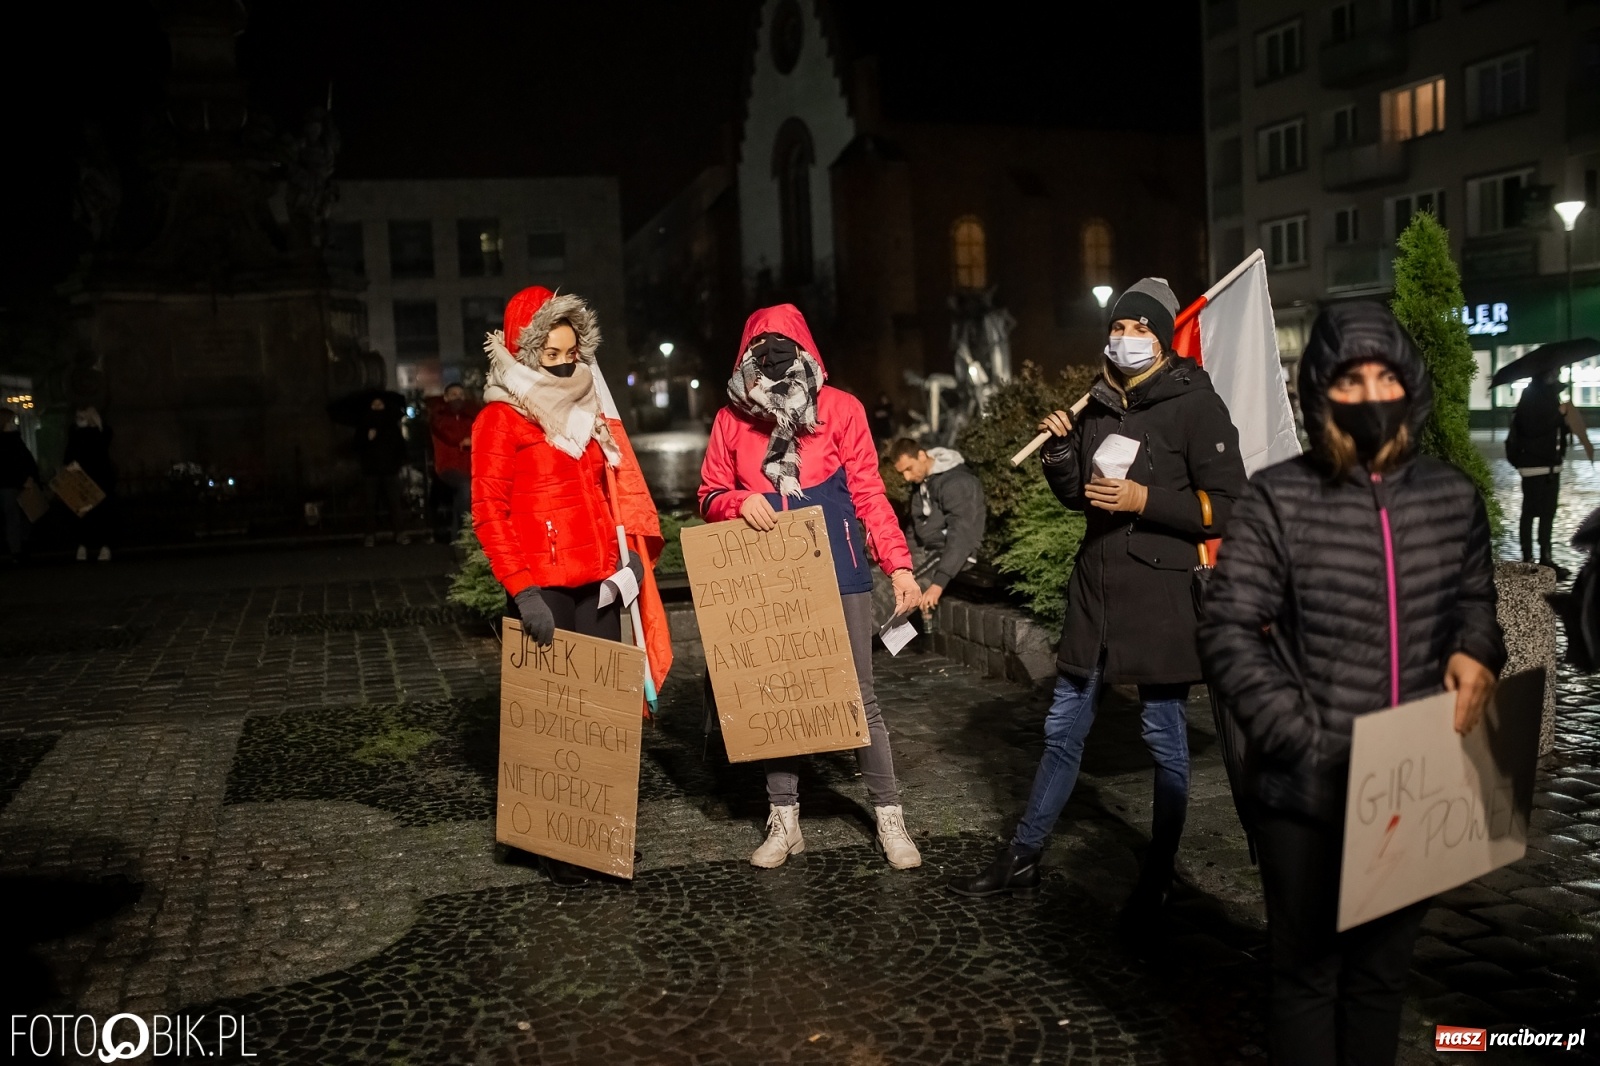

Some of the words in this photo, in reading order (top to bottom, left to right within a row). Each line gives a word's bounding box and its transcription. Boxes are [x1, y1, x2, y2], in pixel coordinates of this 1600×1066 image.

[696, 572, 767, 609] ZAJMIJ
[777, 566, 813, 594] SIĘ
[726, 598, 812, 635] KOTAMI
[508, 627, 580, 680] JAREK
[593, 646, 630, 693] WIE
[713, 644, 730, 672] A
[731, 639, 762, 671] NIE
[766, 626, 840, 663] DZIEĆMI
[540, 678, 592, 718] TYLE
[734, 682, 743, 709] I
[757, 666, 835, 705] KOBIET
[509, 701, 525, 728] O
[534, 708, 628, 753] DZIECIACH
[554, 748, 581, 773] CO
[503, 761, 615, 816] NIETOPERZE
[1355, 756, 1443, 825] GIRL
[511, 801, 532, 835] O
